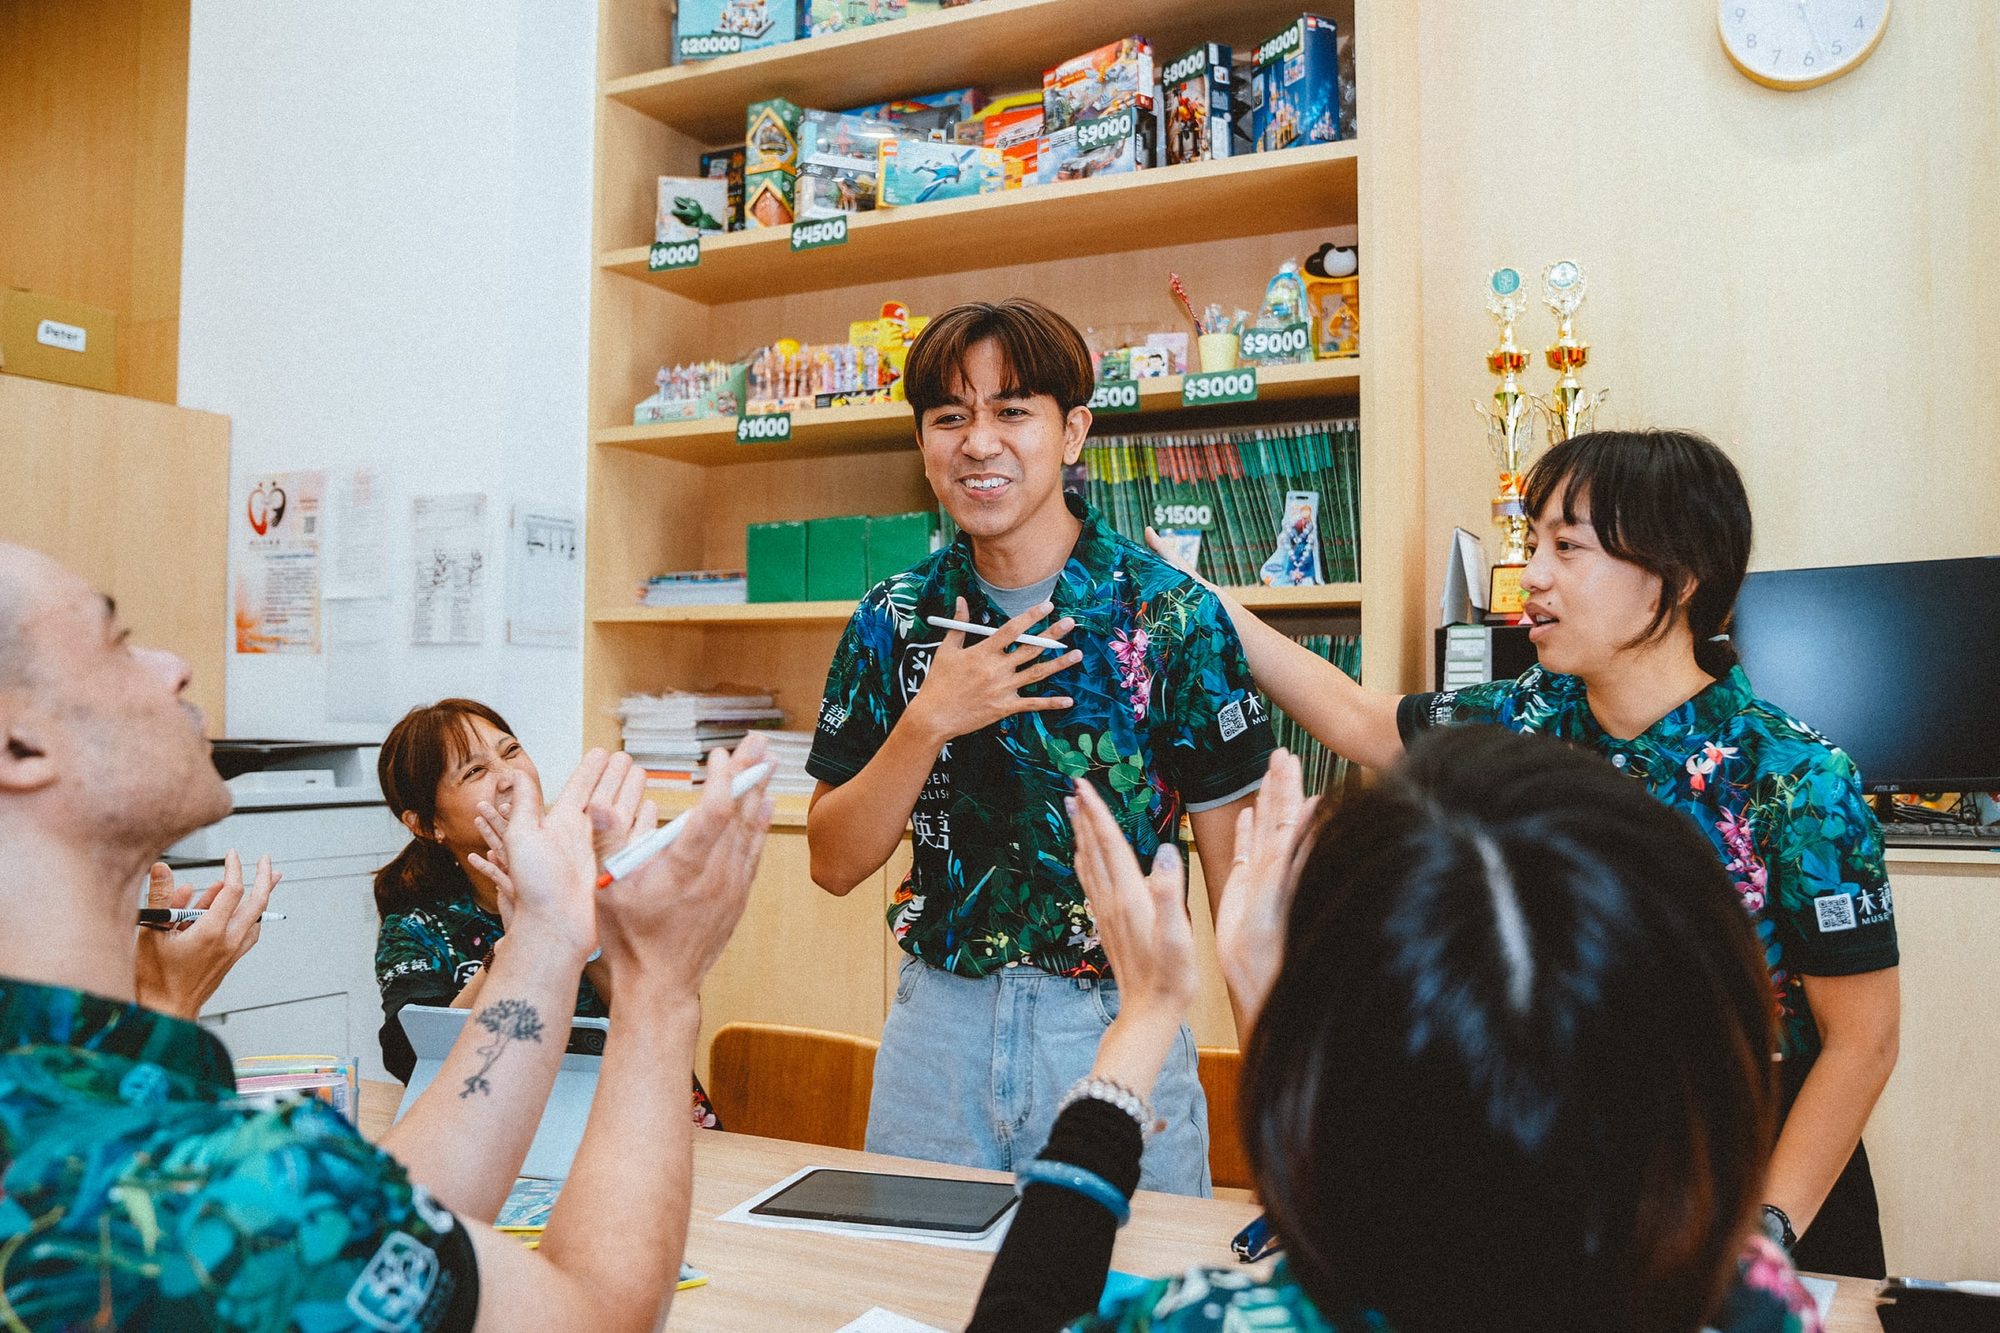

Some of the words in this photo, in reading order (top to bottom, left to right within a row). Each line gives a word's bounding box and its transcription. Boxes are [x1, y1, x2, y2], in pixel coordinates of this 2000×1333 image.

[1734, 8, 1746, 23] 9
[1853, 16, 1864, 29] 4
[681, 35, 741, 54] $20000
[1259, 26, 1298, 64] $18000
[1746, 34, 1757, 48] 8
[1831, 40, 1842, 55] 5
[1163, 49, 1205, 86] $8000
[1772, 50, 1782, 65] 7
[1803, 52, 1815, 66] 6
[1078, 115, 1131, 146] $9000
[792, 219, 845, 248] $4500
[650, 244, 698, 267] $9000
[1243, 328, 1306, 355] $9000
[1184, 373, 1254, 401] $3000
[738, 416, 790, 440] $1000
[1154, 504, 1211, 526] $1500
